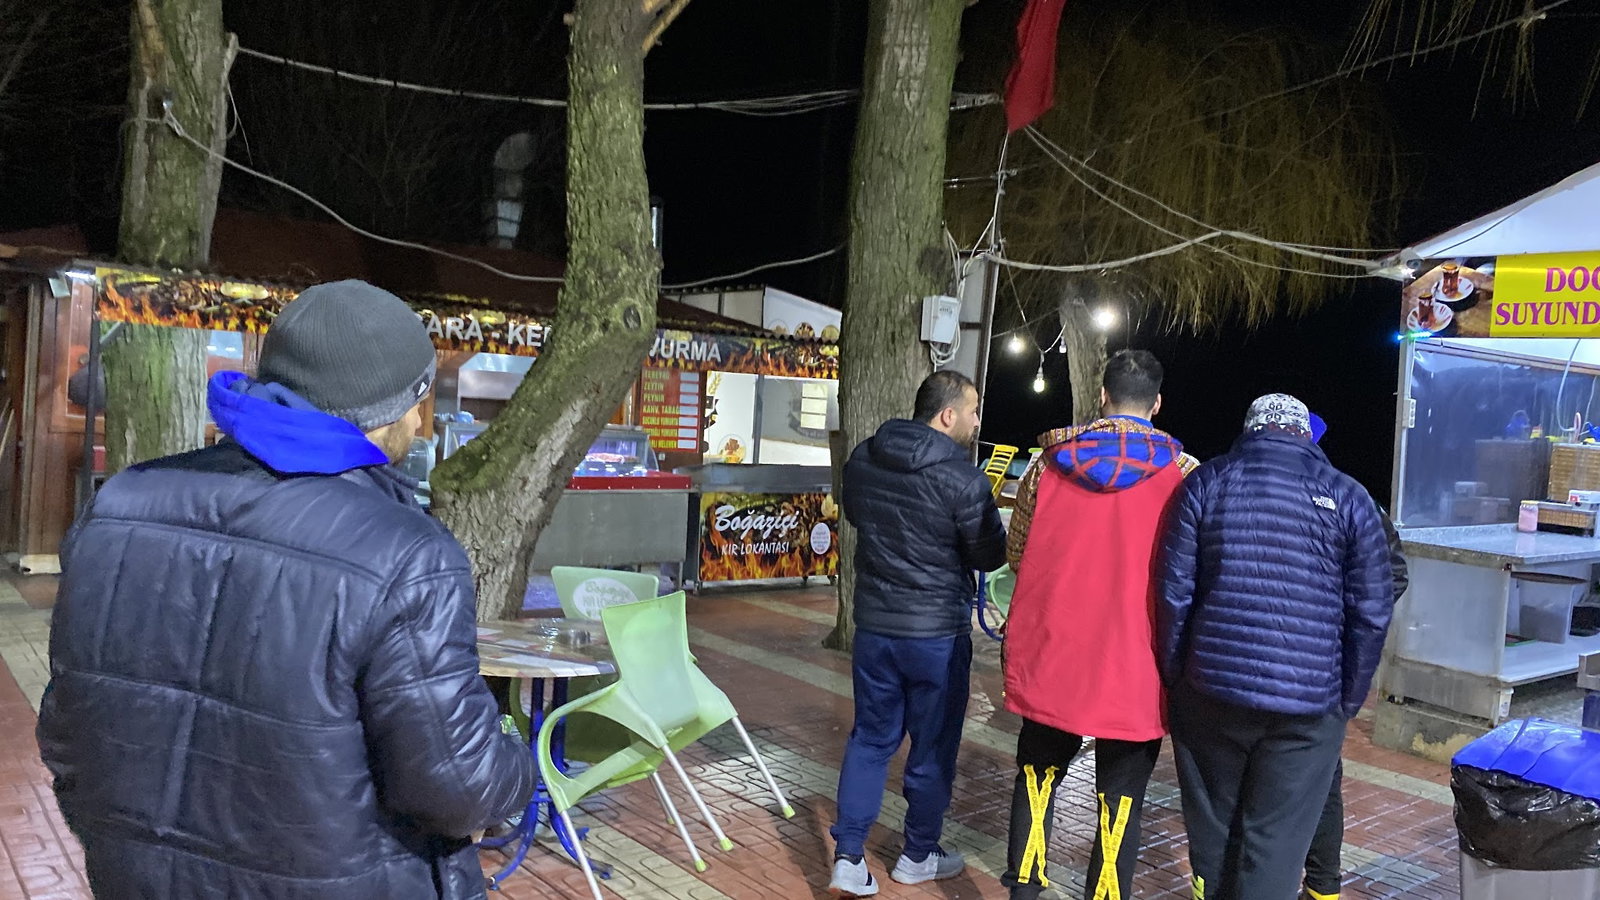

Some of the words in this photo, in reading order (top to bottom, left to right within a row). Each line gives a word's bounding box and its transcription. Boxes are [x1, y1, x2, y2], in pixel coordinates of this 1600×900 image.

[1495, 301, 1600, 325] SUYUND
[426, 313, 484, 342] ARA
[715, 504, 799, 540] Boğaziçi
[721, 543, 739, 556] KIR
[740, 541, 790, 555] LOKANTASI
